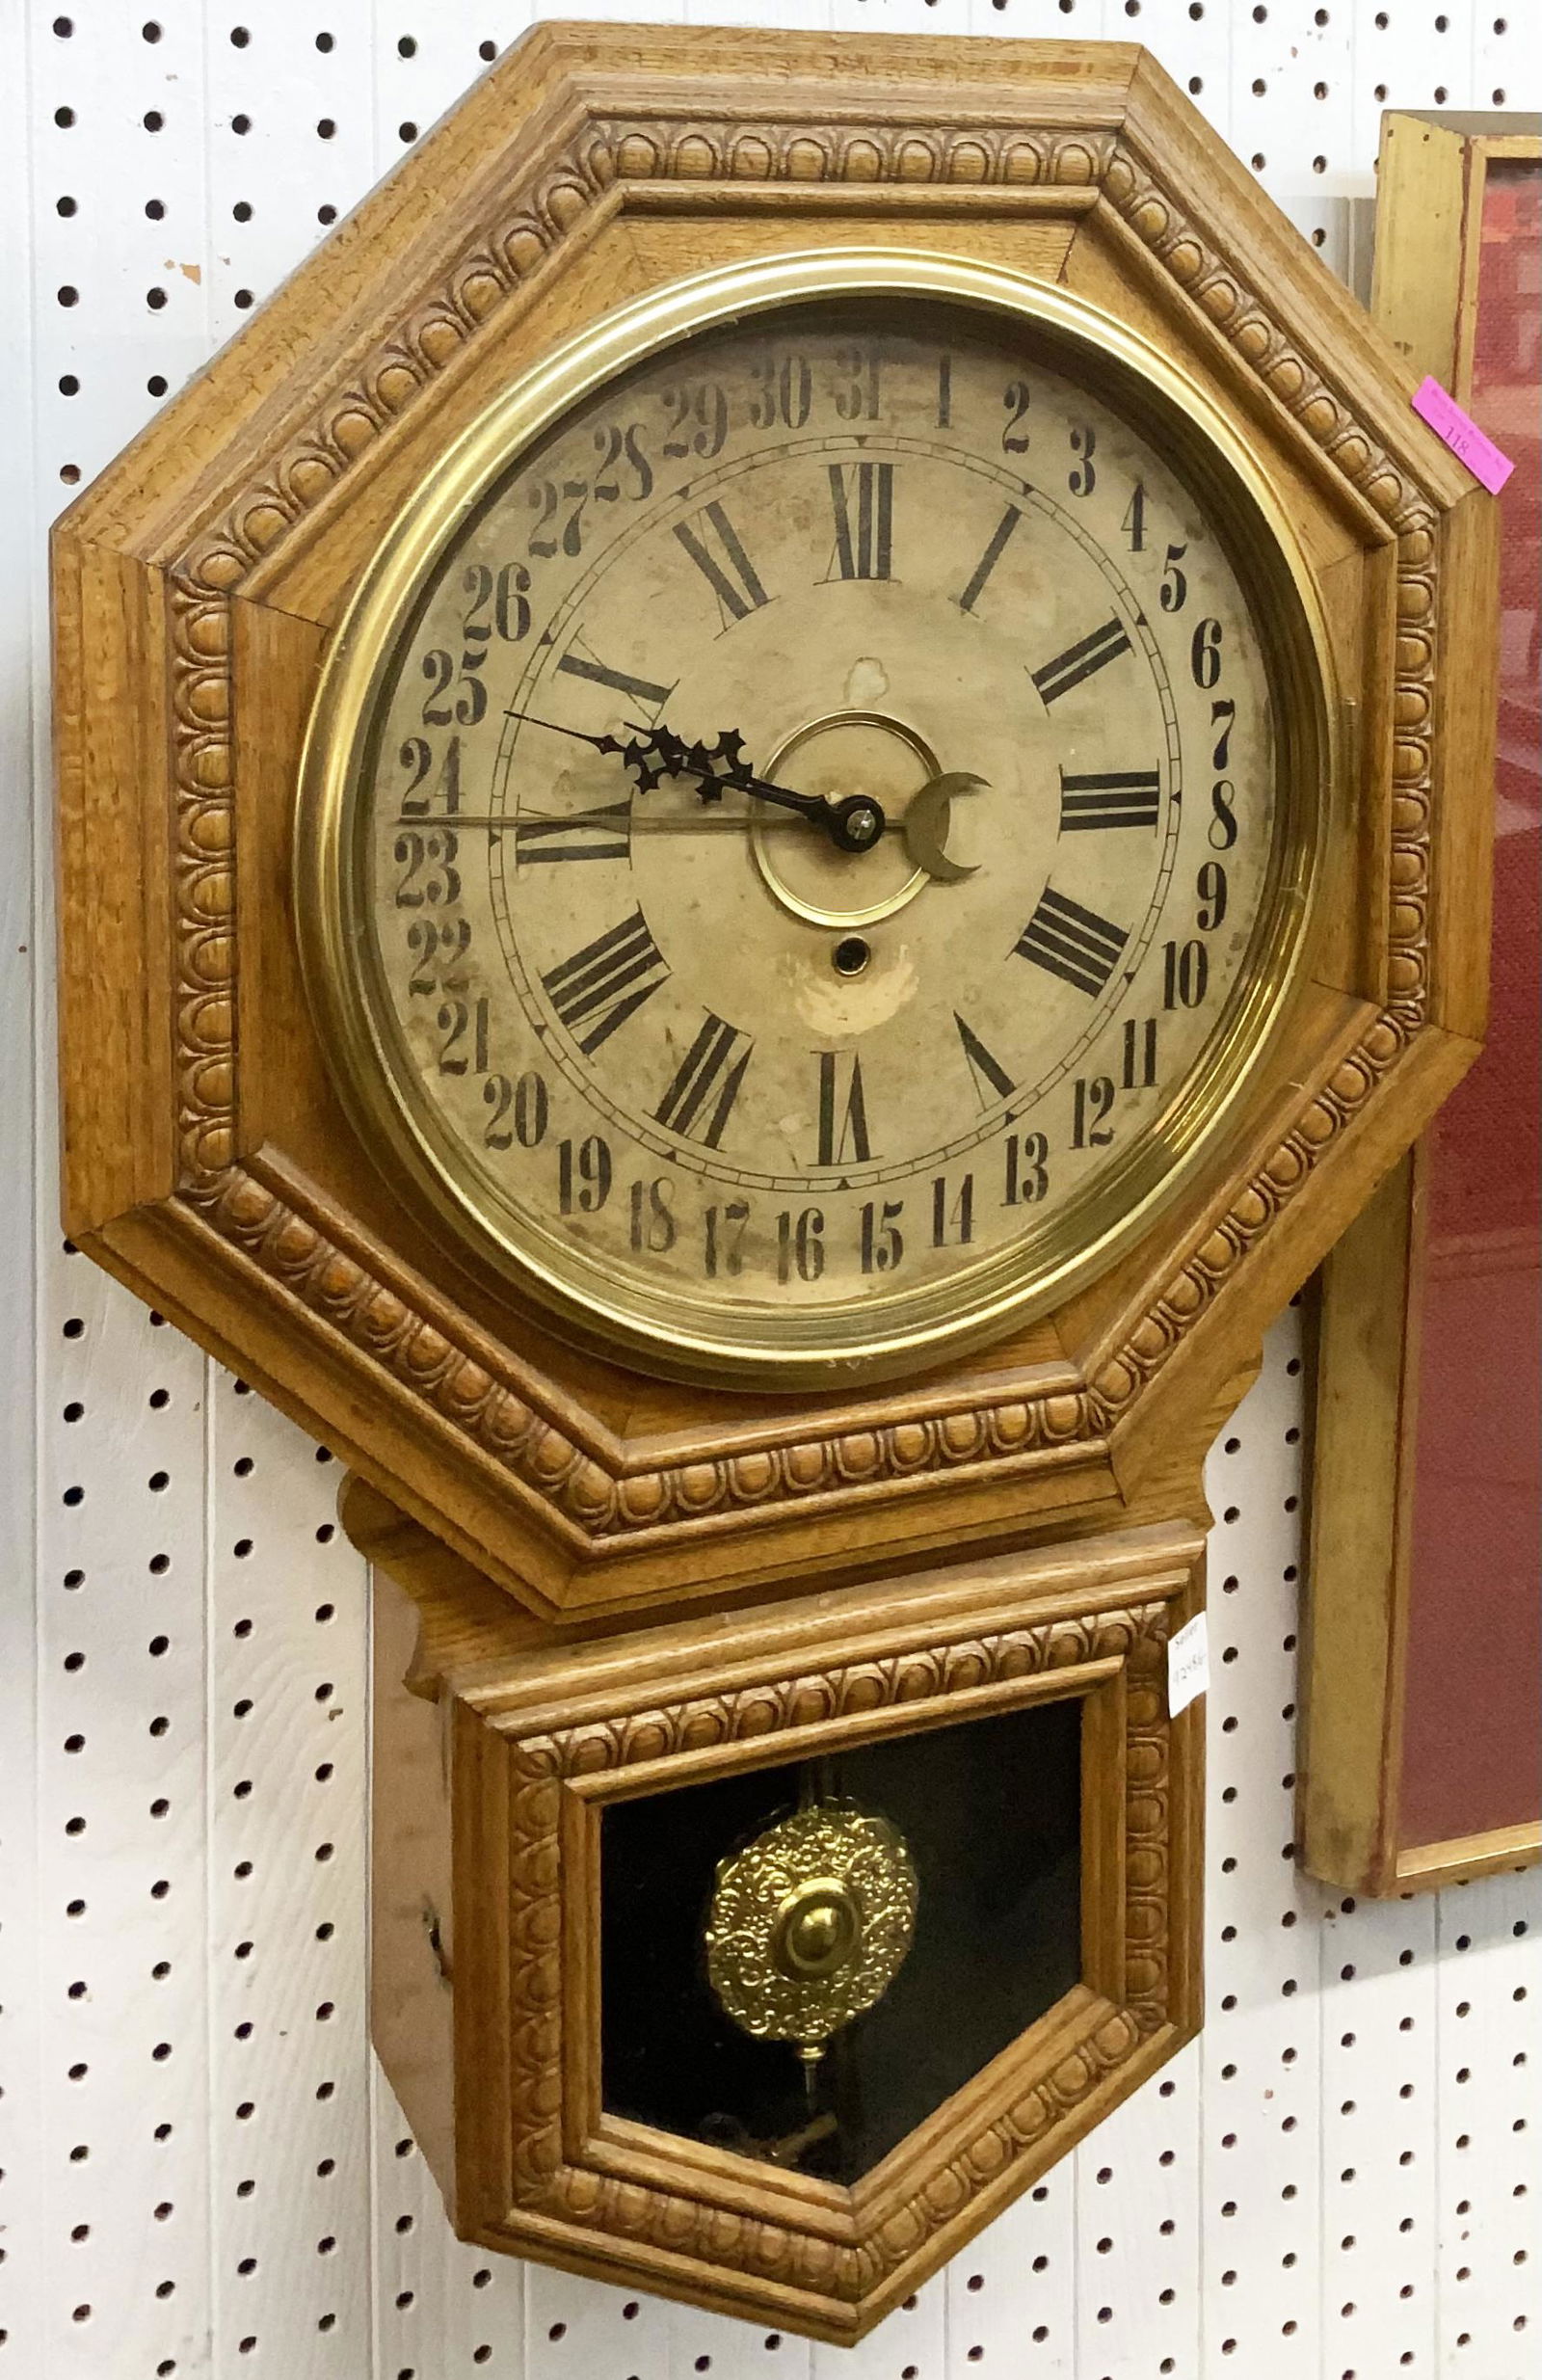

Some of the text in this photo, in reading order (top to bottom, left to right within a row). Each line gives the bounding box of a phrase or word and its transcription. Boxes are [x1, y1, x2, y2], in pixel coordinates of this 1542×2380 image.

[660, 385, 729, 459] 29
[750, 353, 812, 430] 30
[827, 347, 883, 421] 31
[935, 354, 955, 430] 1
[1001, 381, 1030, 454] 2
[594, 422, 653, 502] 28
[1069, 425, 1096, 497] 3
[1445, 425, 1471, 456] 118
[527, 479, 589, 559] 27
[813, 462, 903, 586] XII
[1121, 483, 1148, 552] 4
[673, 495, 782, 641] XI
[948, 500, 1031, 623] I
[1159, 543, 1188, 613] 5
[463, 562, 532, 643] 26
[421, 647, 489, 728] 25
[551, 623, 681, 729] X
[1024, 605, 1137, 717] II
[1191, 617, 1223, 690] 6
[1210, 698, 1236, 771] 7
[398, 735, 466, 816] 24
[1057, 758, 1160, 845] III
[1207, 779, 1237, 851] 8
[393, 829, 462, 908] 23
[1196, 860, 1228, 932] 9
[407, 917, 472, 997] 22
[1004, 873, 1135, 1003] IIII
[1162, 939, 1210, 1011] 10
[534, 898, 674, 1067] VIII
[437, 996, 491, 1076] 21
[952, 1008, 1026, 1119] V
[1119, 1018, 1160, 1090] 11
[483, 1070, 548, 1151] 20
[641, 1004, 757, 1154] VII
[807, 1049, 886, 1167] VI
[1068, 1076, 1116, 1150] 12
[555, 1134, 613, 1216] 19
[999, 1131, 1050, 1208] 13
[629, 1176, 676, 1254] 18
[704, 1201, 751, 1278] 17
[774, 1207, 825, 1285] 16
[859, 1199, 904, 1275] 15
[931, 1173, 976, 1248] 14
